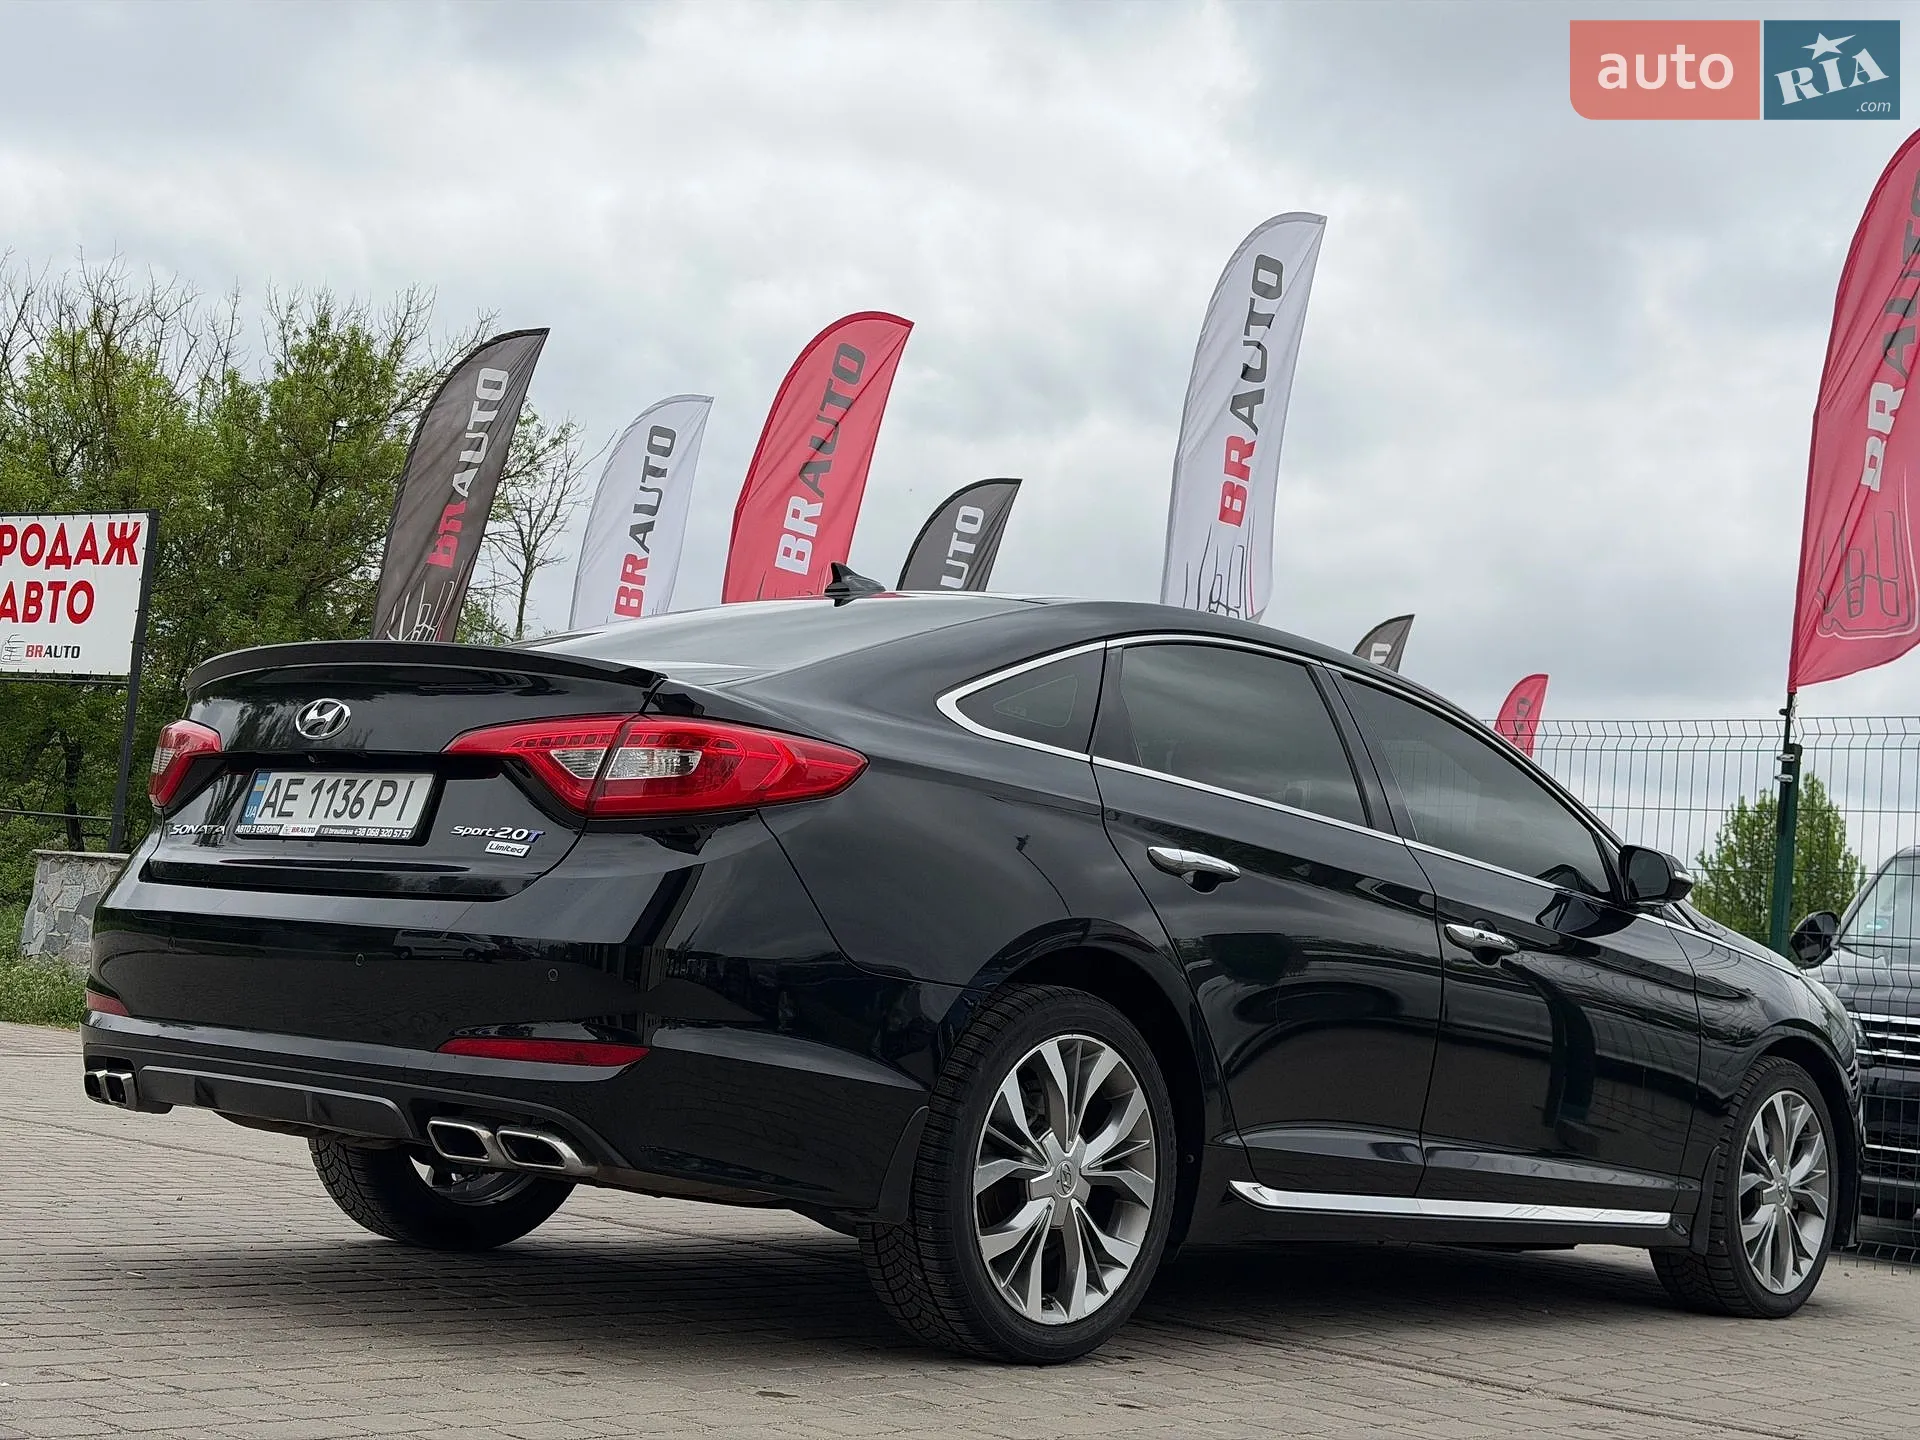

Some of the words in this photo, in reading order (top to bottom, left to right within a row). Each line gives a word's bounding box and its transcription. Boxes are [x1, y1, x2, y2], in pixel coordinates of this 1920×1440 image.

[1217, 253, 1284, 528] BRAUTO
[426, 367, 509, 568] BRAUTO
[774, 342, 866, 576] BRAUTO
[614, 424, 677, 618] BRAUTO
[0, 521, 141, 570] РОДАЖ
[940, 505, 985, 589] UTO
[0, 580, 95, 625] АВТО
[25, 645, 80, 659] BRAUTO
[245, 805, 257, 818] UA
[258, 778, 305, 818] AE
[308, 778, 373, 819] 1136
[368, 780, 415, 821] PI
[169, 824, 225, 835] SONATA
[291, 826, 316, 834] BRAUTO
[380, 829, 392, 838] 320
[450, 825, 495, 837] Sport
[494, 826, 545, 843] 2.0T
[489, 842, 525, 854] Limited
